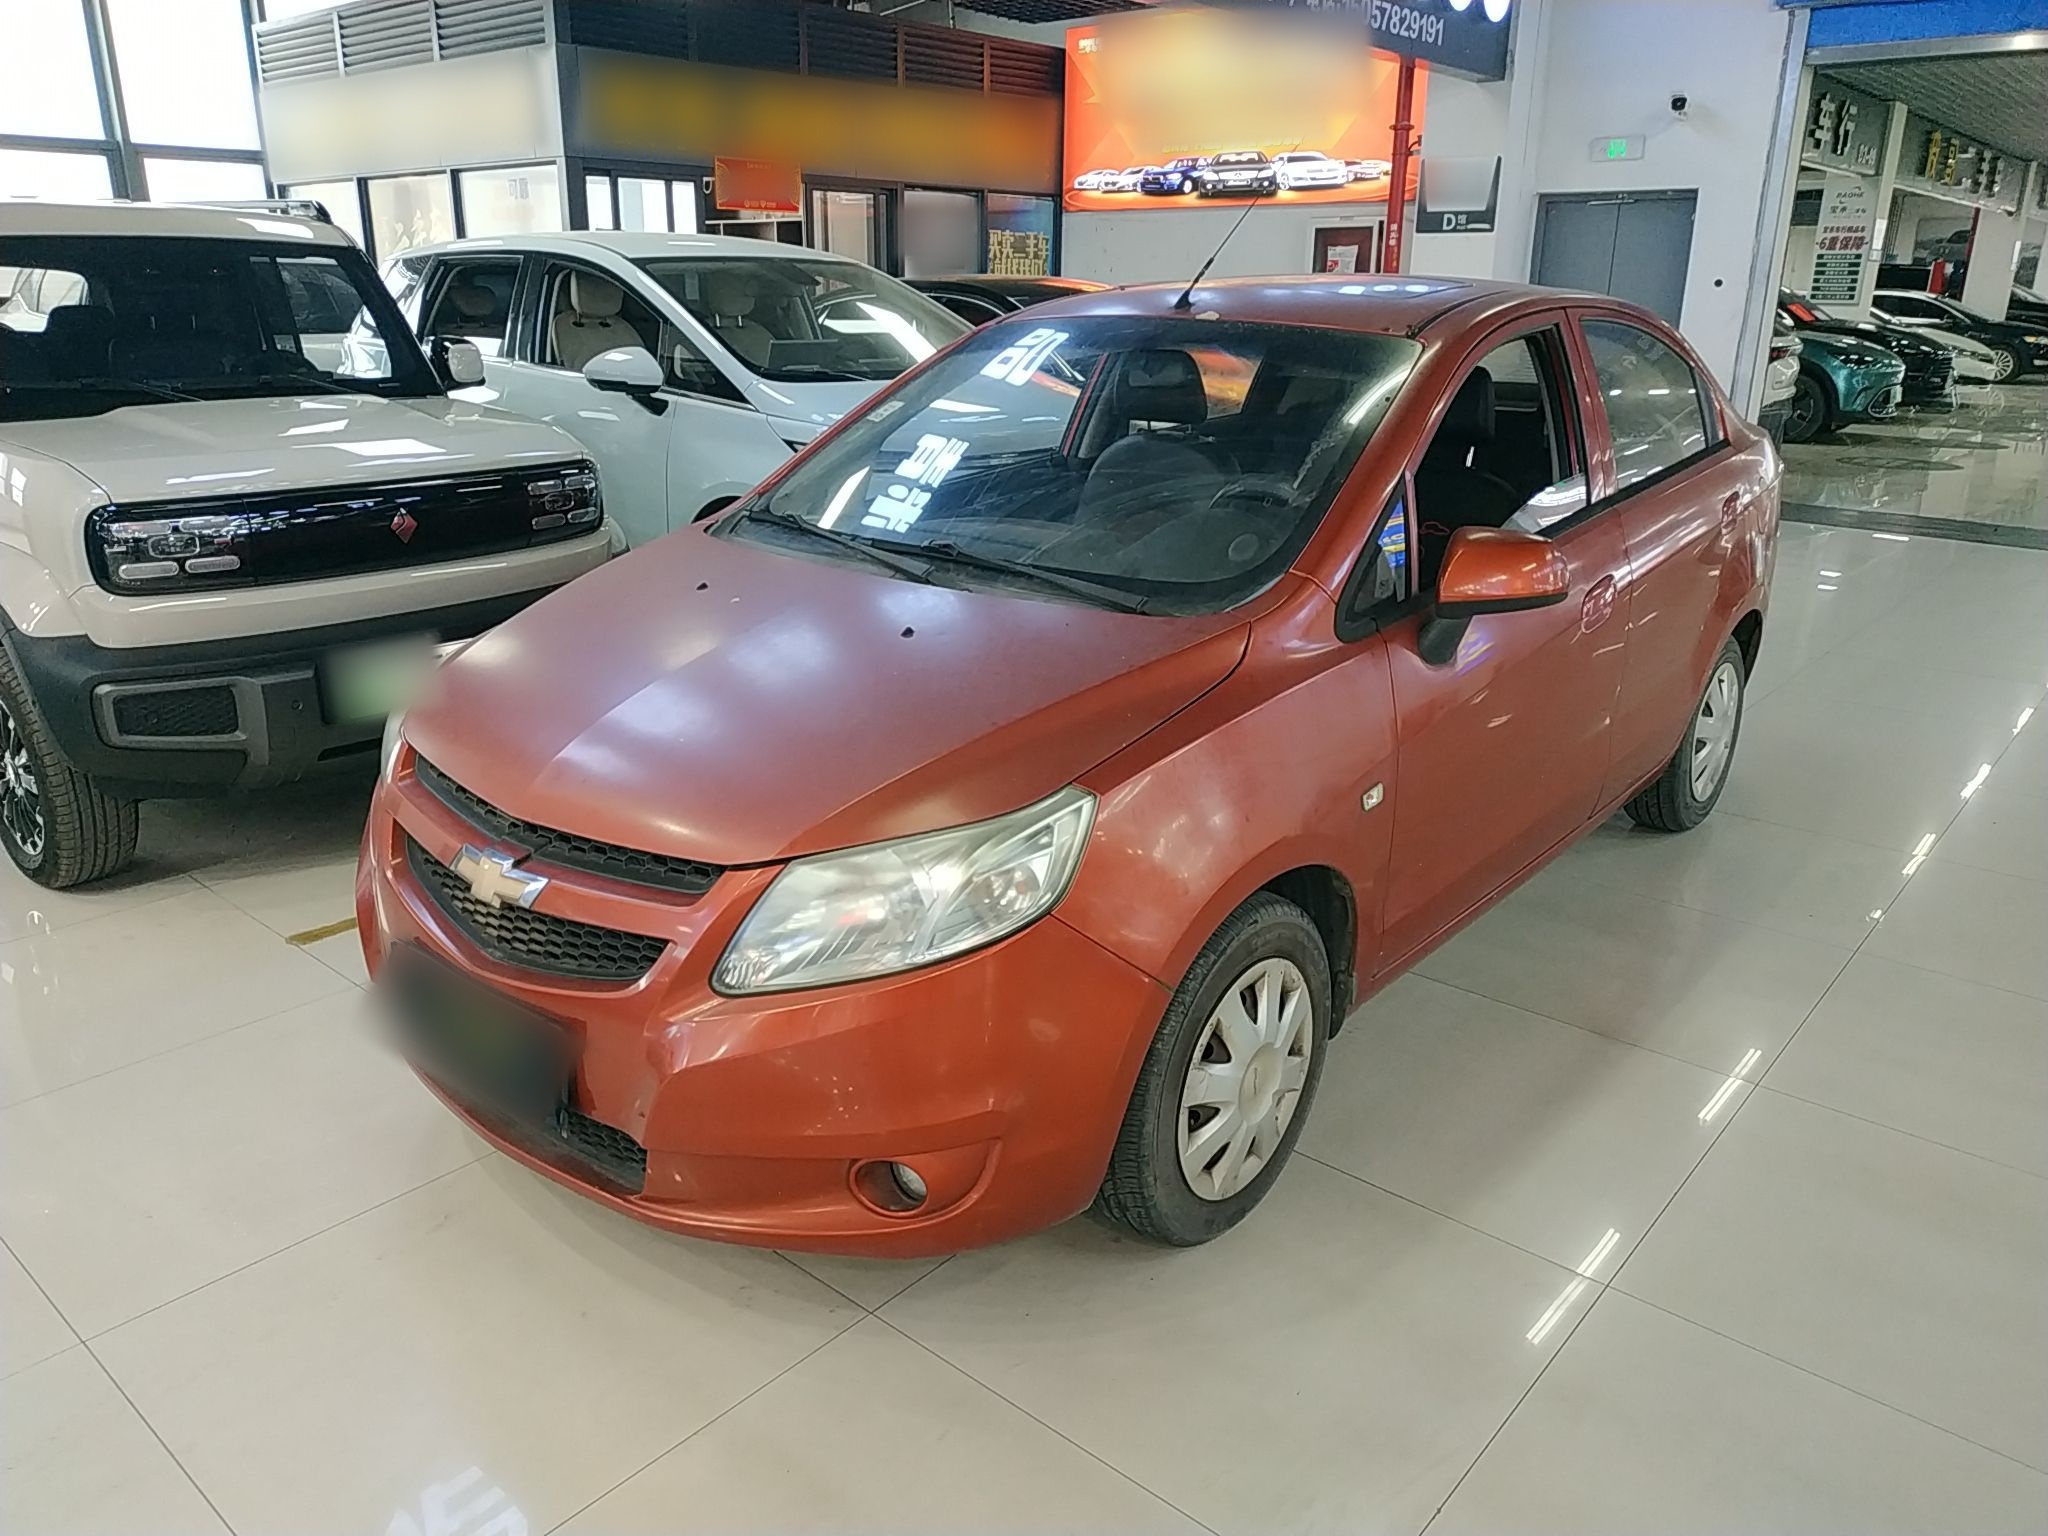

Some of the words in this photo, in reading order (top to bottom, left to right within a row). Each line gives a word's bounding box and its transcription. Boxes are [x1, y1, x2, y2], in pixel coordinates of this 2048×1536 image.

[989, 229, 1049, 260] 买卖二手车
